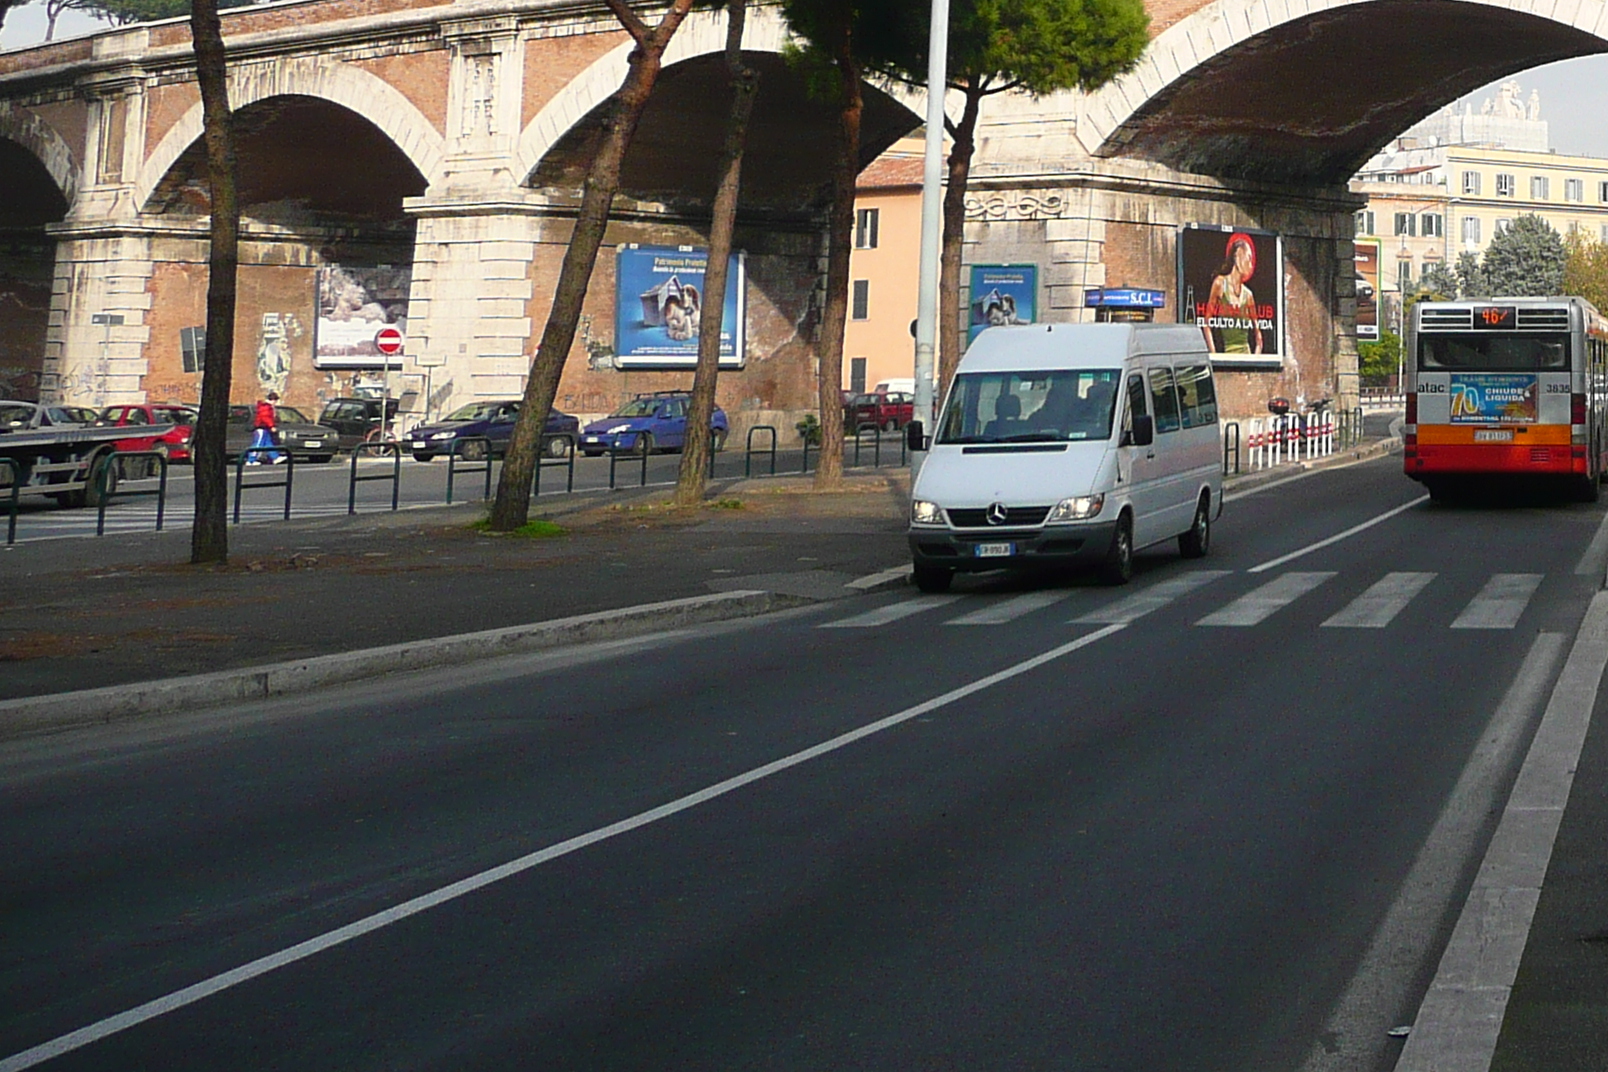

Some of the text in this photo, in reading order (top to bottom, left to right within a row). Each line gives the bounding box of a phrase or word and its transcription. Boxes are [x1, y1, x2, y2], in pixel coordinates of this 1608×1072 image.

[1243, 304, 1274, 319] CLUB
[1196, 317, 1273, 330] EL CULTO A LA VIDA
[1418, 382, 1445, 393] atac
[1546, 383, 1571, 394] 3835
